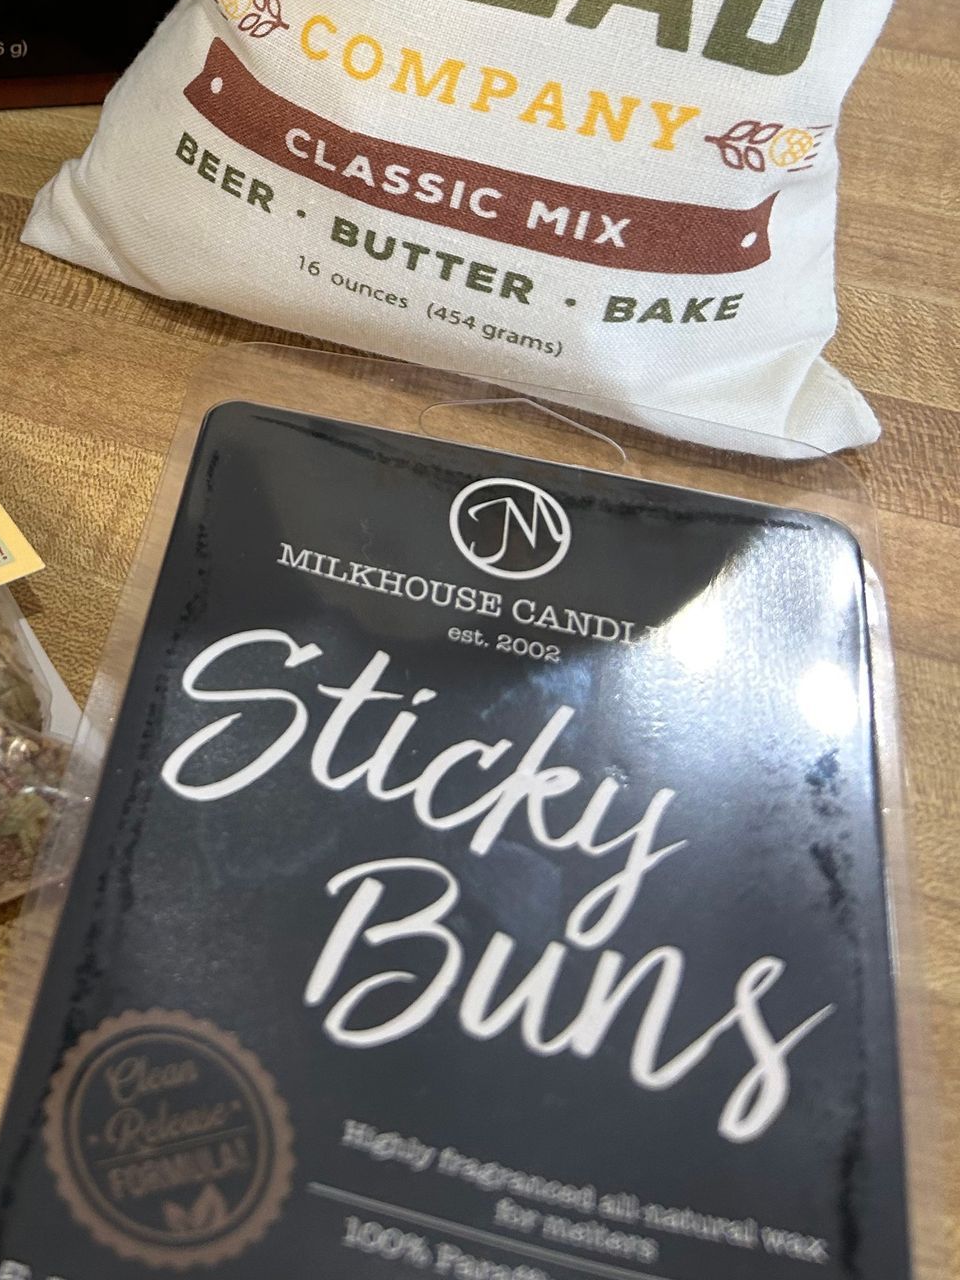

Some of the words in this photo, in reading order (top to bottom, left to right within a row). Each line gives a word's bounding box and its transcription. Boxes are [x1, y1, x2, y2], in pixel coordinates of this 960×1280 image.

[9, 39, 28, 58] g)
[298, 14, 702, 152] COMPANY
[174, 131, 276, 214] BEER
[330, 216, 535, 306] BUTTER
[601, 292, 744, 324] BAKE
[283, 126, 502, 219] CLASSIC
[527, 198, 635, 249] MIX
[296, 254, 321, 278] 16
[330, 271, 410, 311] ounces
[427, 300, 476, 332] (454
[481, 320, 564, 358] grams)
[276, 542, 503, 616] MILKHOUSE
[512, 598, 662, 646] CANDL
[448, 624, 489, 648] est.
[496, 633, 561, 664] 2002
[160, 628, 688, 950] Sticky
[304, 858, 836, 1144] Buns
[342, 1216, 434, 1269] 100%
[758, 1225, 832, 1264] wax
